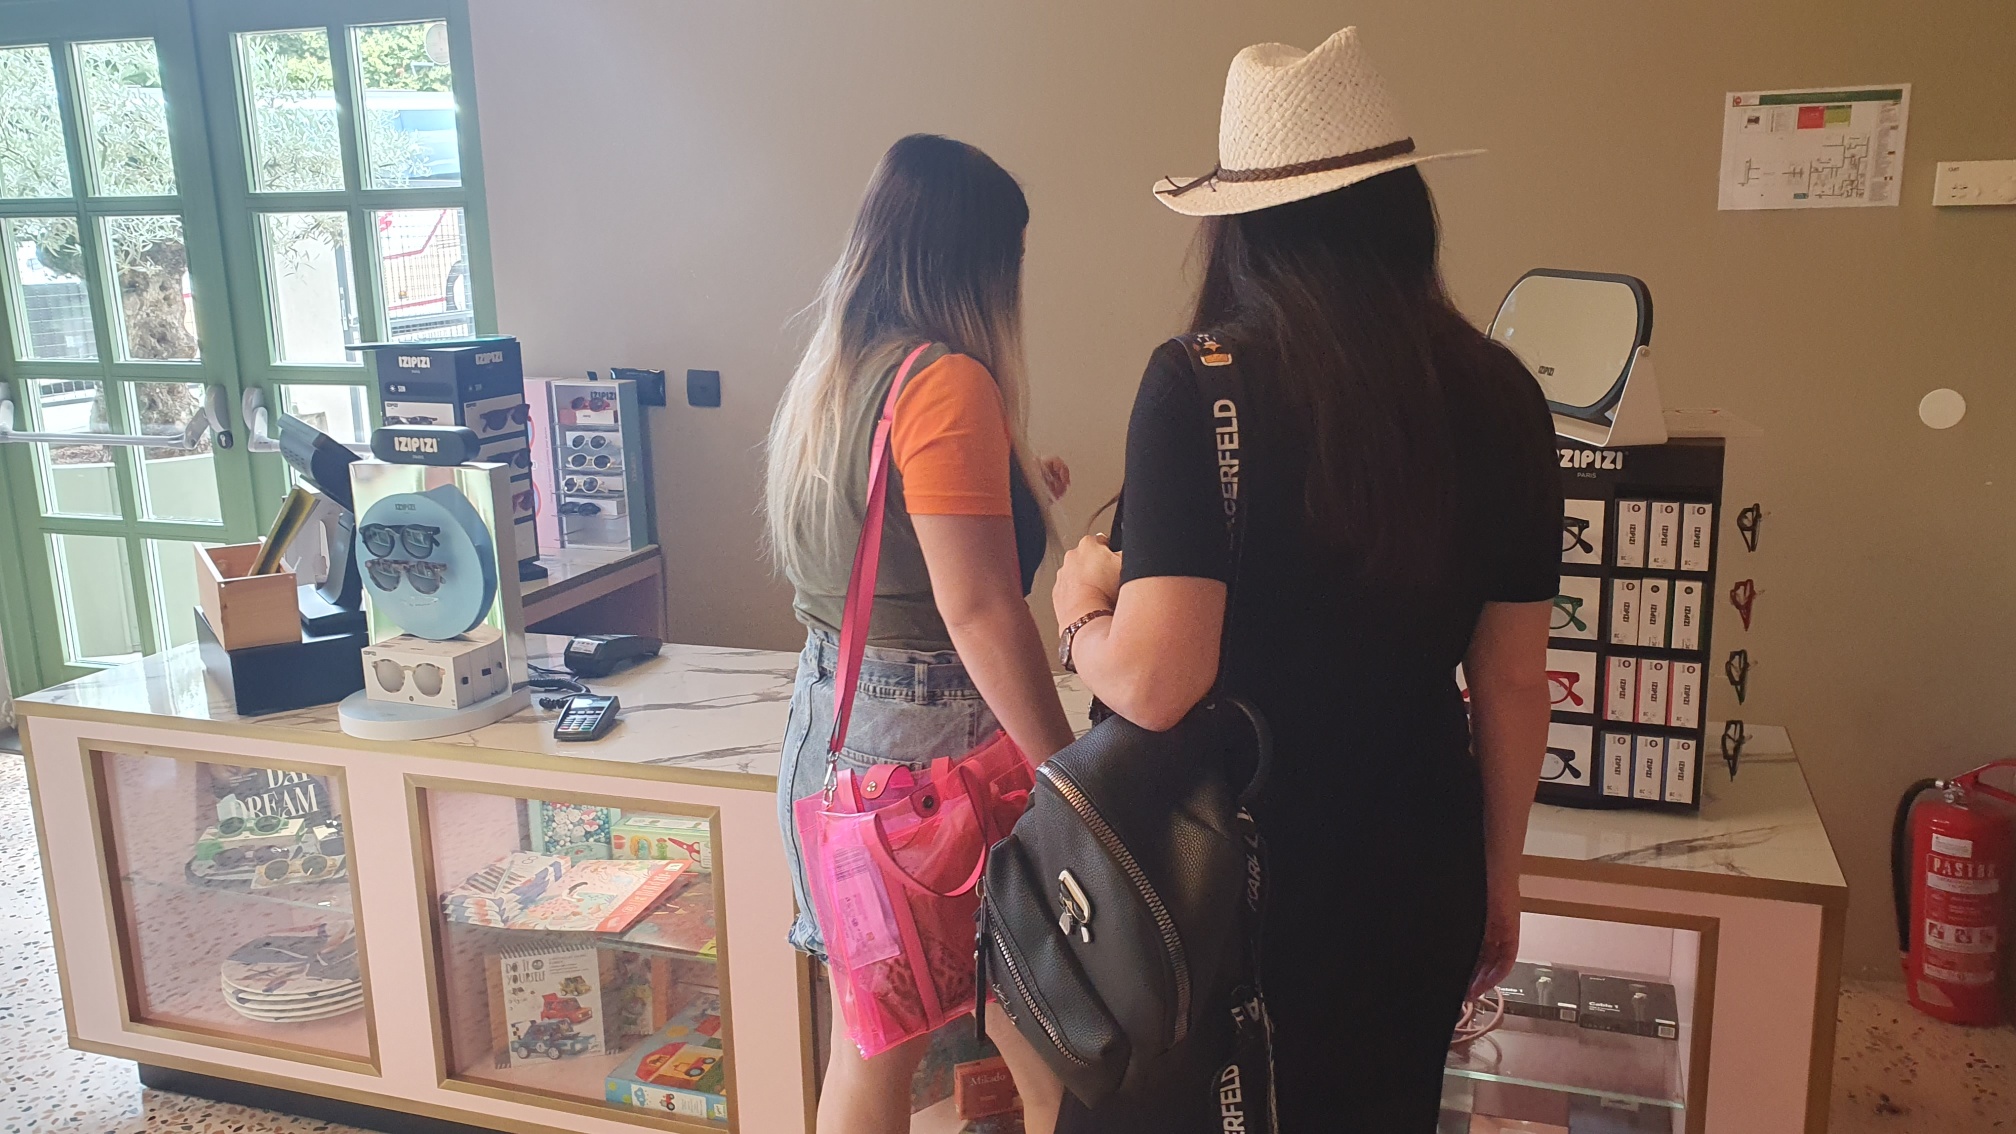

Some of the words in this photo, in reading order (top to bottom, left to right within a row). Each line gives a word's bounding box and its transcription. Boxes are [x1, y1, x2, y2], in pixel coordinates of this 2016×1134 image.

[398, 356, 431, 369] IZIPIZI
[394, 436, 438, 453] IZIPIZI
[1556, 448, 1623, 470] ZIPIZI
[1577, 471, 1597, 479] PARIS
